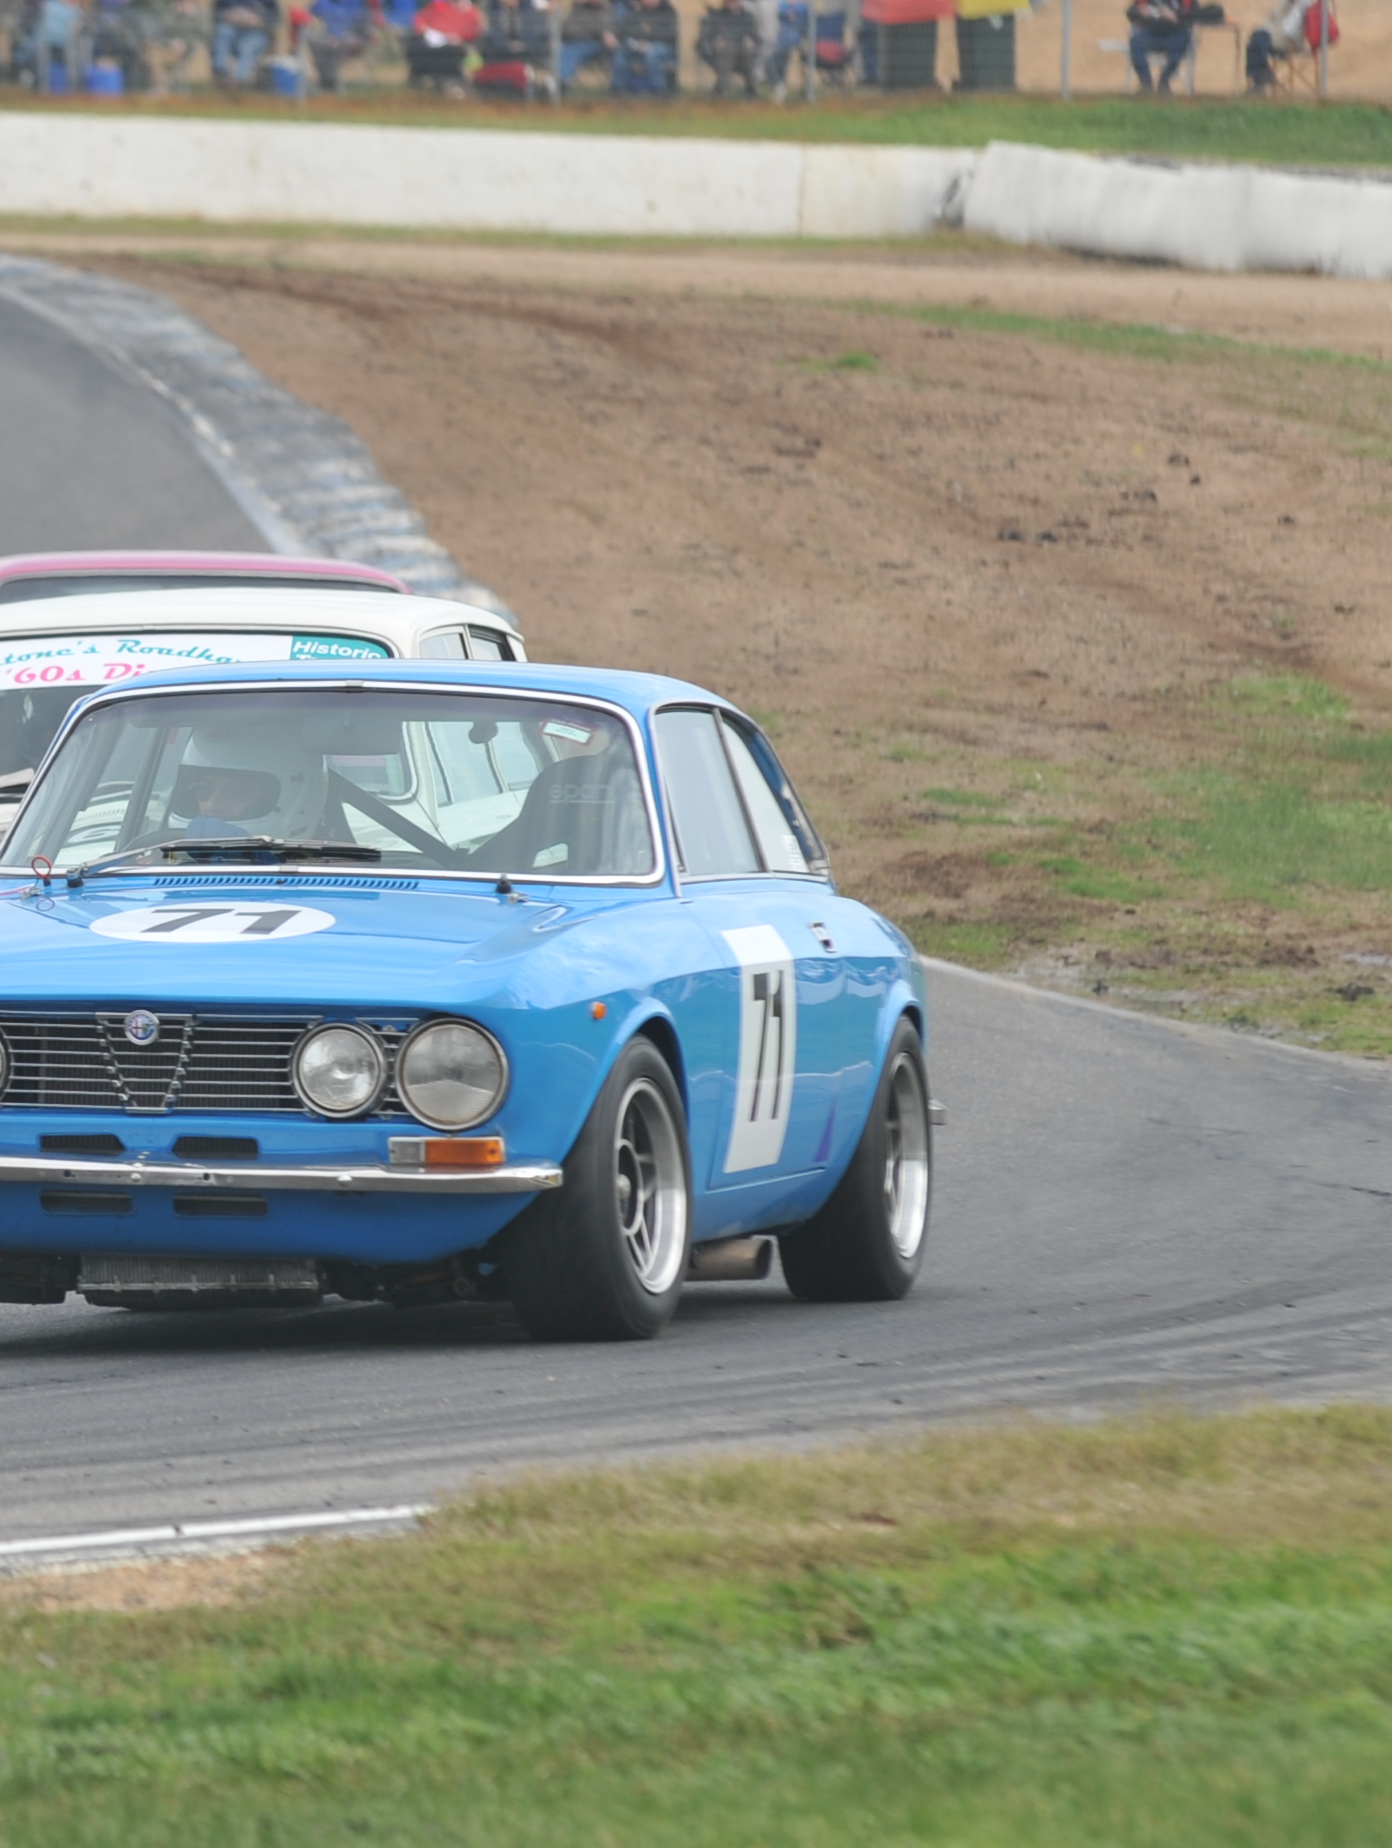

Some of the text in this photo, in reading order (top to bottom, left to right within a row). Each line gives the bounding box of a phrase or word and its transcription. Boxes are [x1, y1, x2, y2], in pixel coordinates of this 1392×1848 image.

[117, 639, 241, 663] Roadho
[292, 641, 382, 659] Historic
[103, 663, 155, 680] Di
[140, 908, 302, 935] 71
[749, 969, 785, 1122] 71
